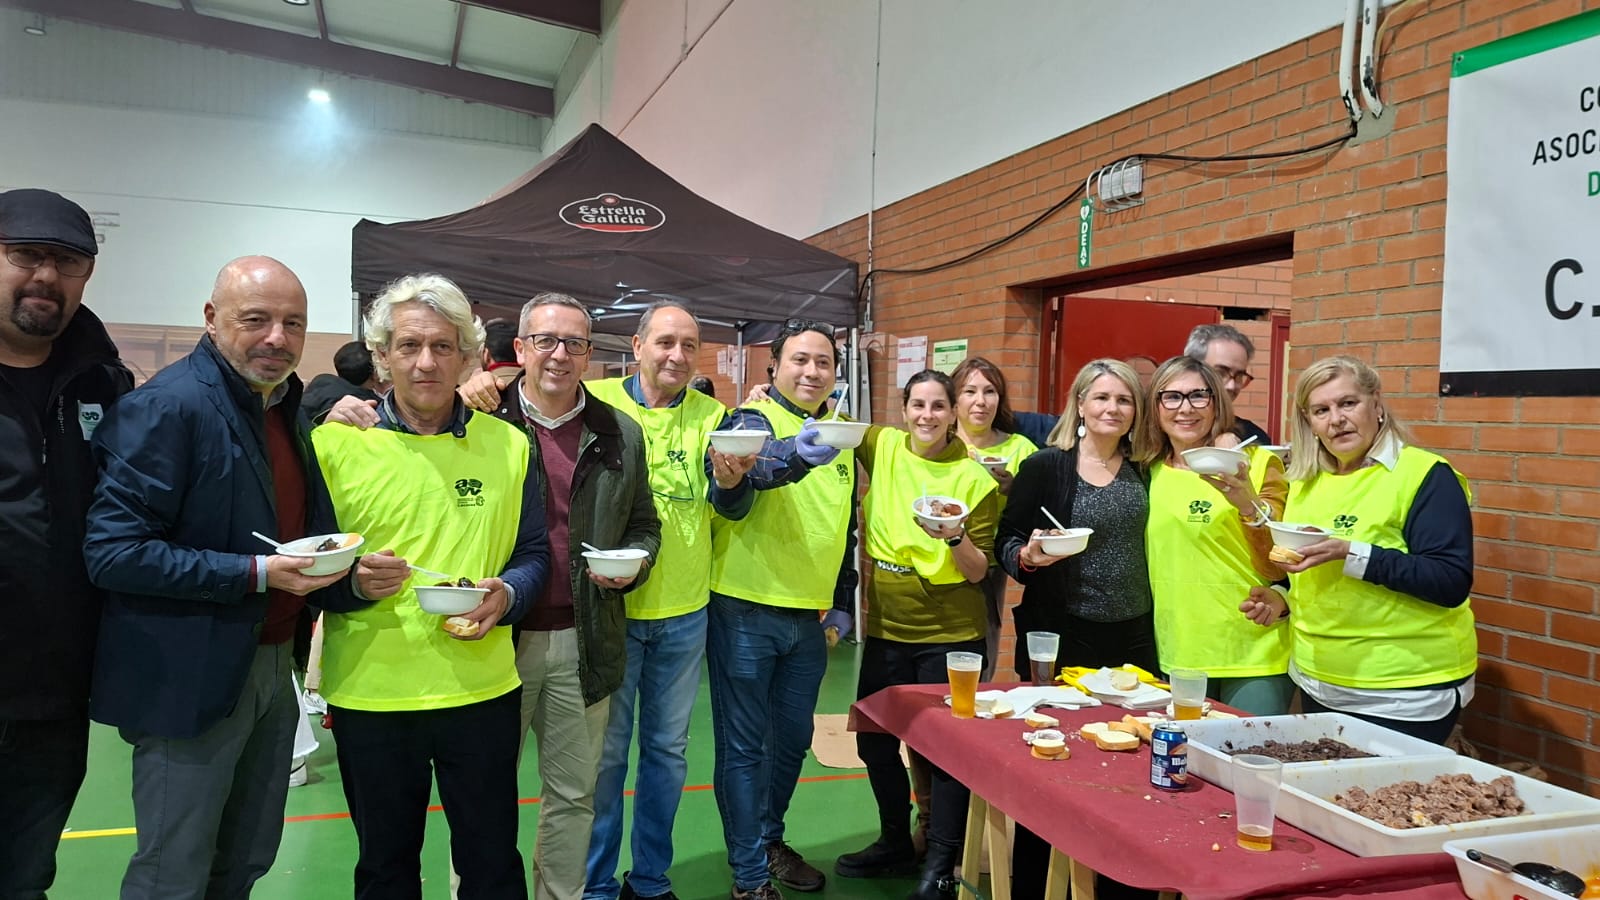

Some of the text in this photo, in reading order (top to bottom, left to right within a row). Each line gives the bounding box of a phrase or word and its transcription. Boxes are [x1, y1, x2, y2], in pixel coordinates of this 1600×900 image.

[1580, 86, 1600, 113] C
[1532, 129, 1600, 166] ASOC
[578, 205, 647, 216] Estrella
[581, 214, 645, 224] Galicia
[1080, 221, 1088, 258] DEA
